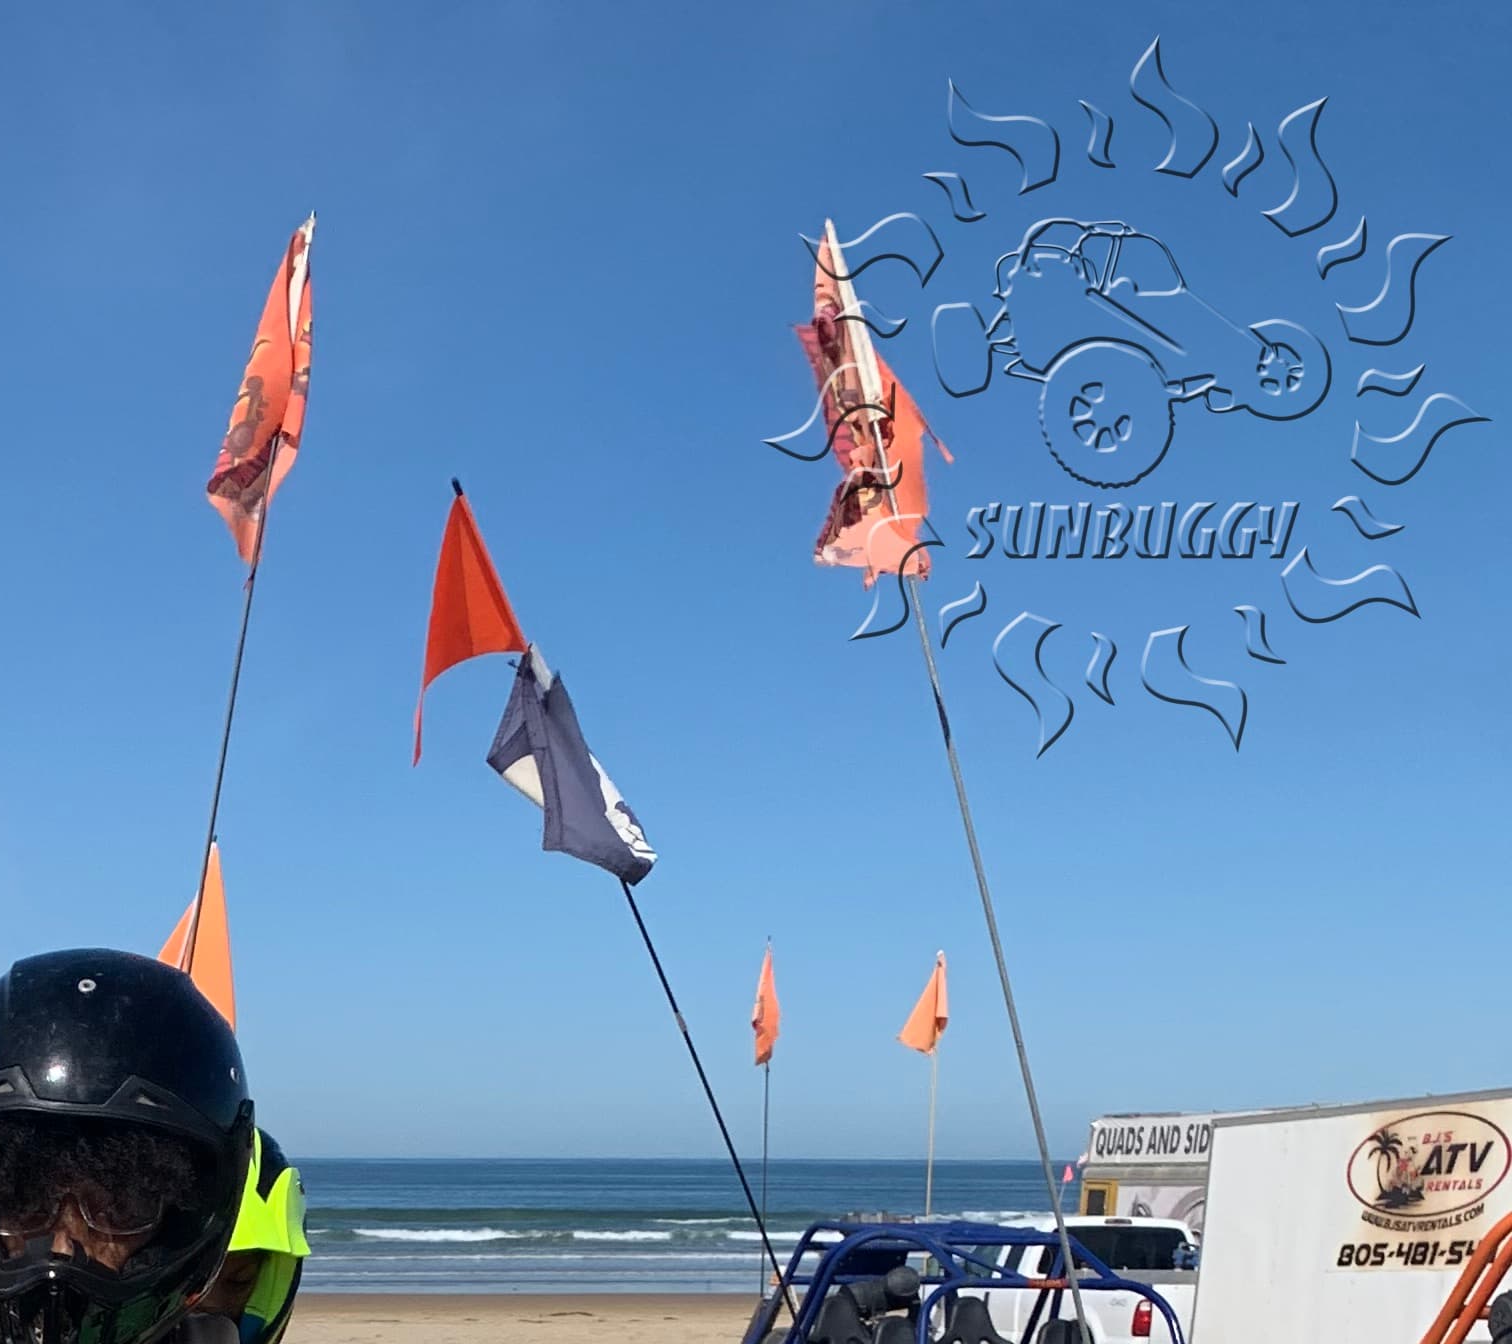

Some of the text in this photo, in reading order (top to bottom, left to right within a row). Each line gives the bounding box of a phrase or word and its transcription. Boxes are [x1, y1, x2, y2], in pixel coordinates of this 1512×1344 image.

[1096, 1126, 1145, 1157] QUADS
[1146, 1125, 1181, 1154] AND
[1421, 1141, 1494, 1176] ATV
[1425, 1178, 1484, 1193] RENTALS
